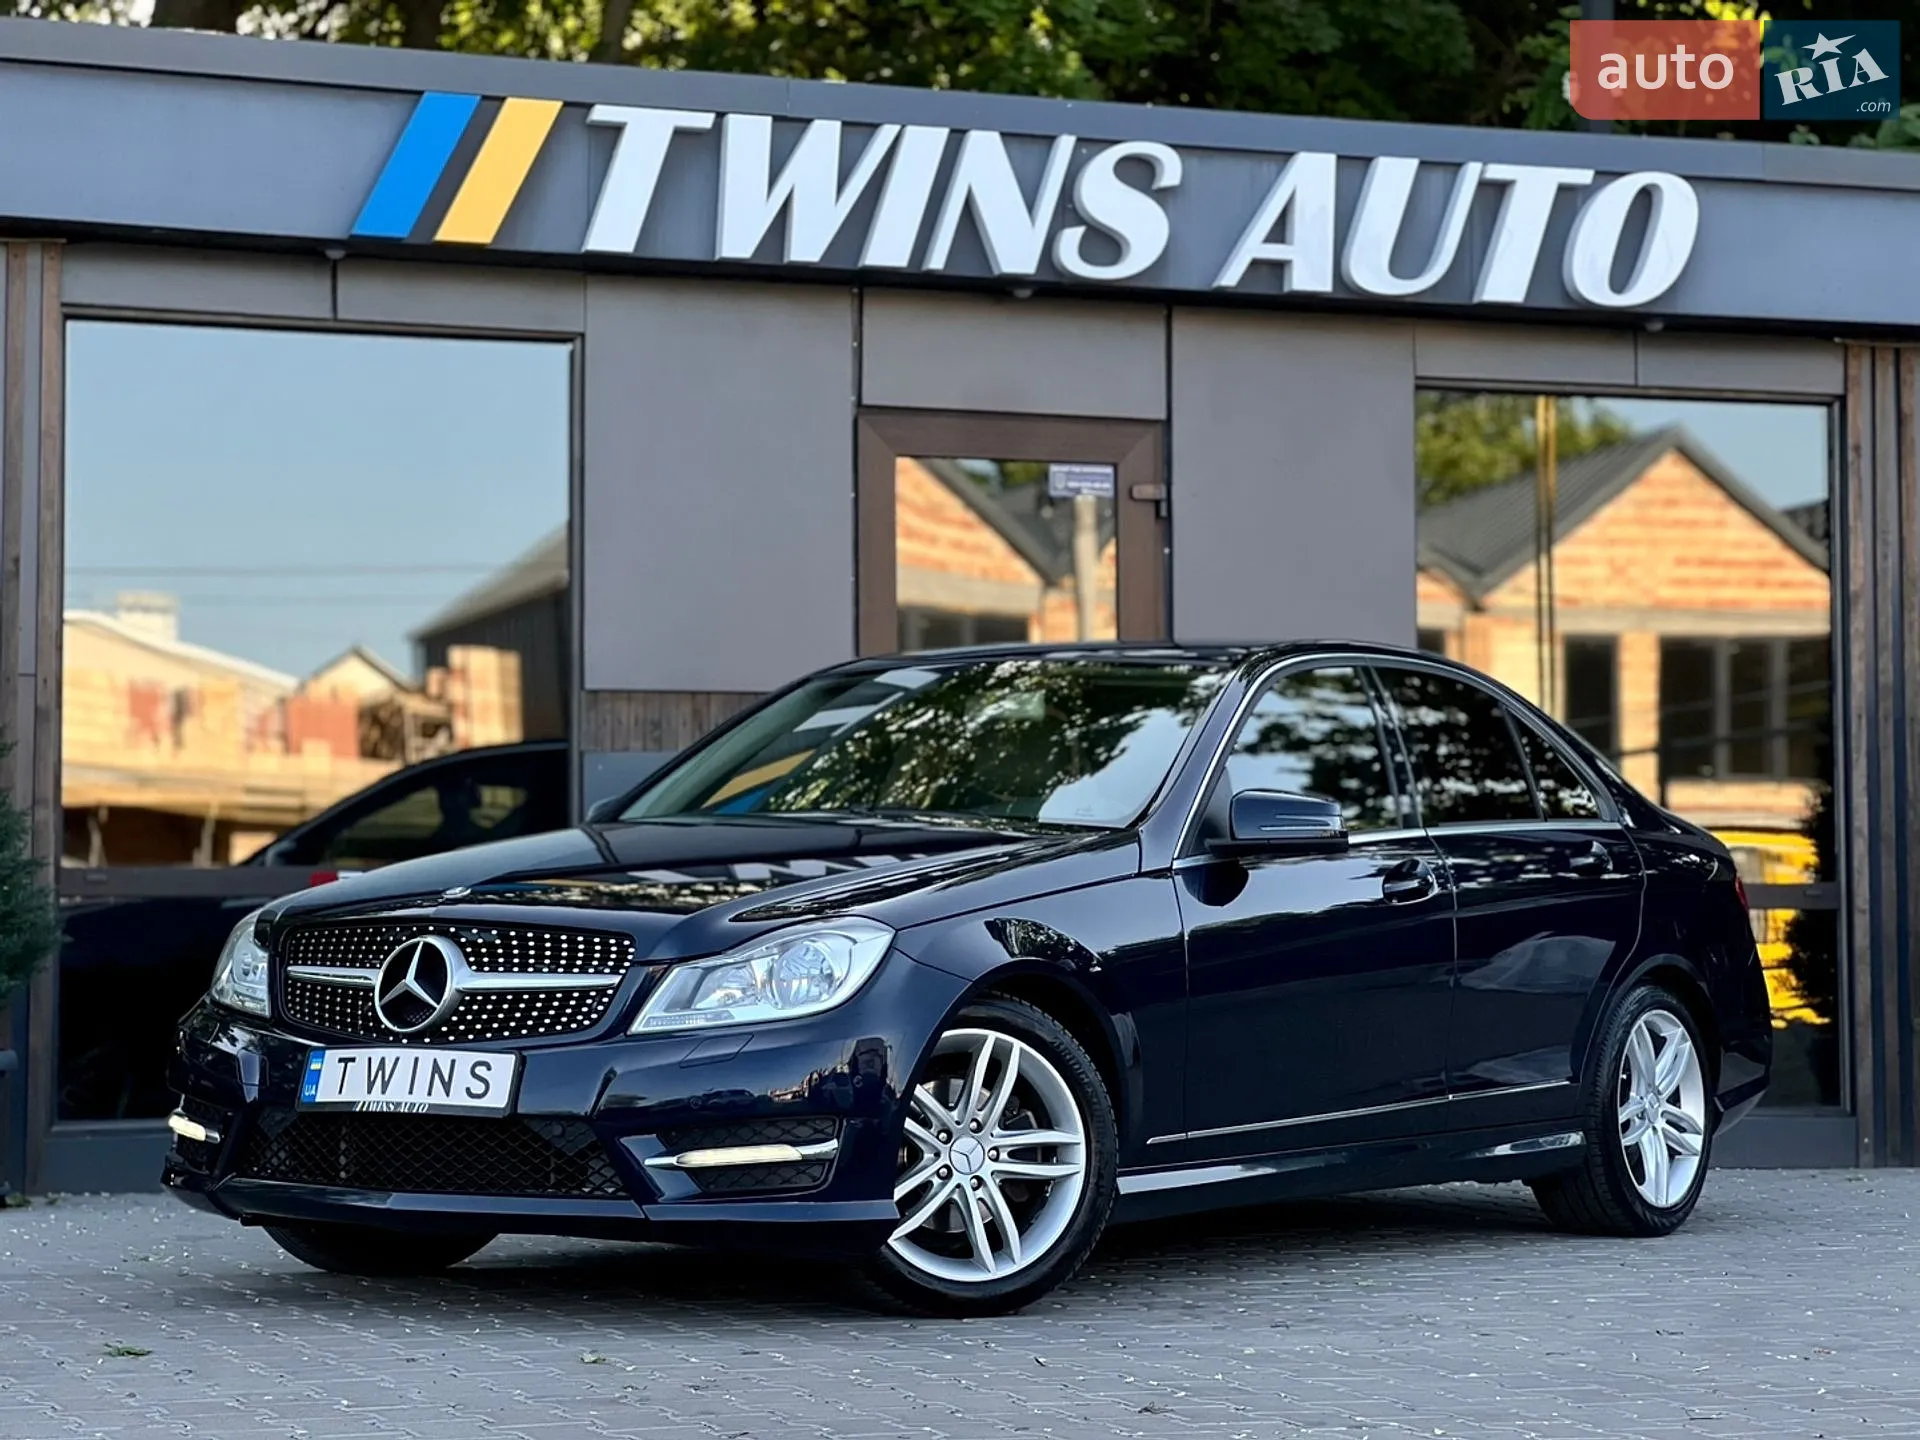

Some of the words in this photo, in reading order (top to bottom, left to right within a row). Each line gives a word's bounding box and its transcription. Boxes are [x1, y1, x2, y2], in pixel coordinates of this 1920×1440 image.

[581, 104, 1183, 281] TWINS
[1211, 151, 1700, 307] AUTO
[304, 1084, 316, 1096] UA
[337, 1056, 492, 1099] TWINS
